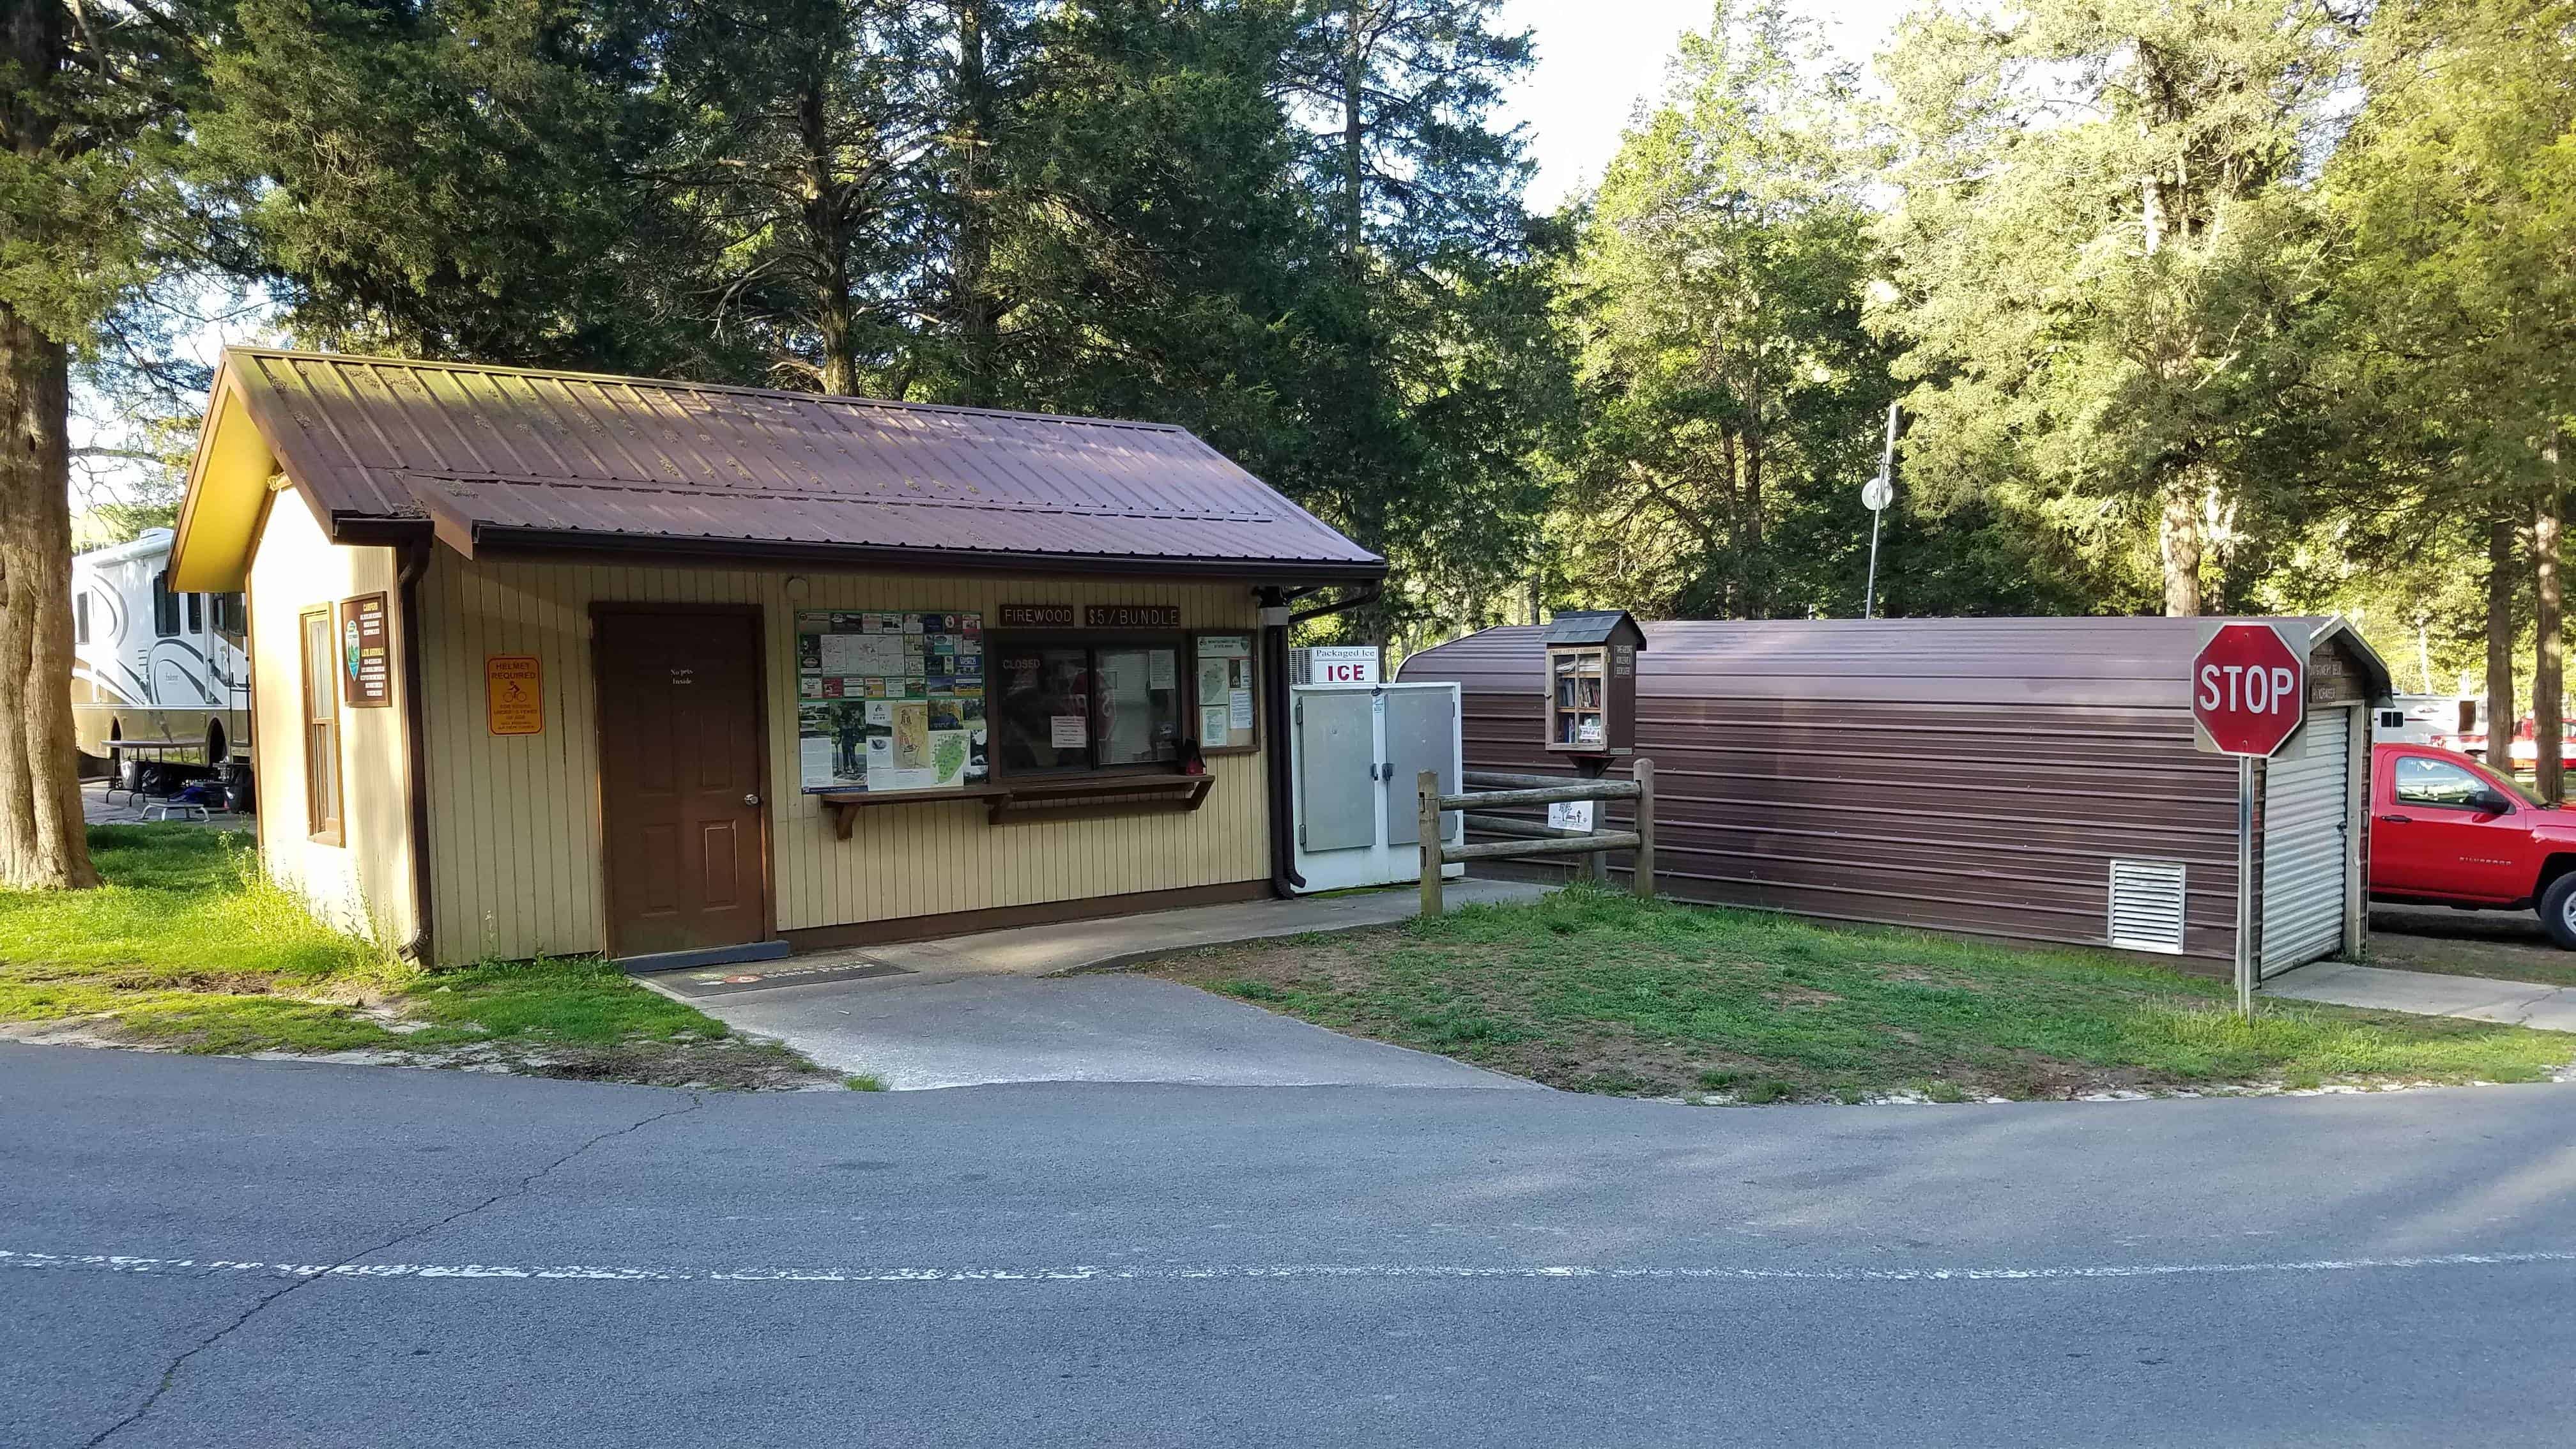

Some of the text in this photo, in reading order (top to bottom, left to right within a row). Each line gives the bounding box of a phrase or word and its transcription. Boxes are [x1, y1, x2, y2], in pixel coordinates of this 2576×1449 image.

[1005, 609, 1072, 622] FIREWOOD
[1316, 649, 1359, 658] Packaged
[1002, 659, 1041, 670] CLOSED
[491, 671, 537, 680] REQUIRED
[1328, 664, 1365, 682] ICE
[2198, 664, 2294, 715] STOP
